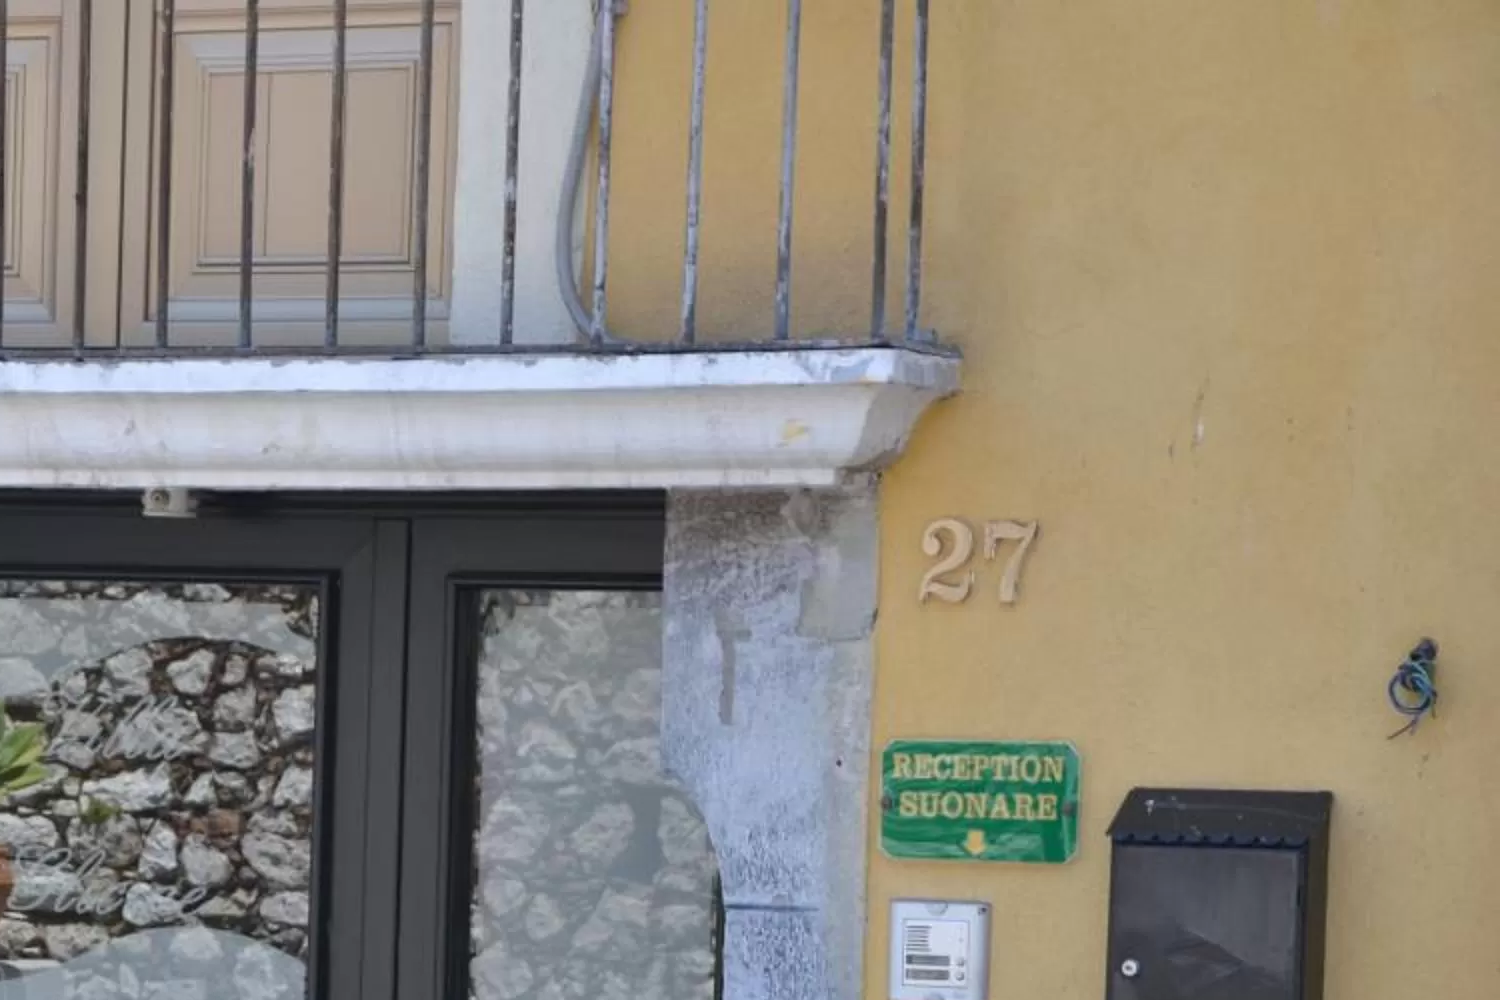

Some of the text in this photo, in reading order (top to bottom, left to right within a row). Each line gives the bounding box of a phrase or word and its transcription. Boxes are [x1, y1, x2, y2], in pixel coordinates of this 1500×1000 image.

[919, 517, 1039, 604] 27
[891, 751, 1066, 784] RECEPTION
[899, 790, 1059, 821] SUONARE
